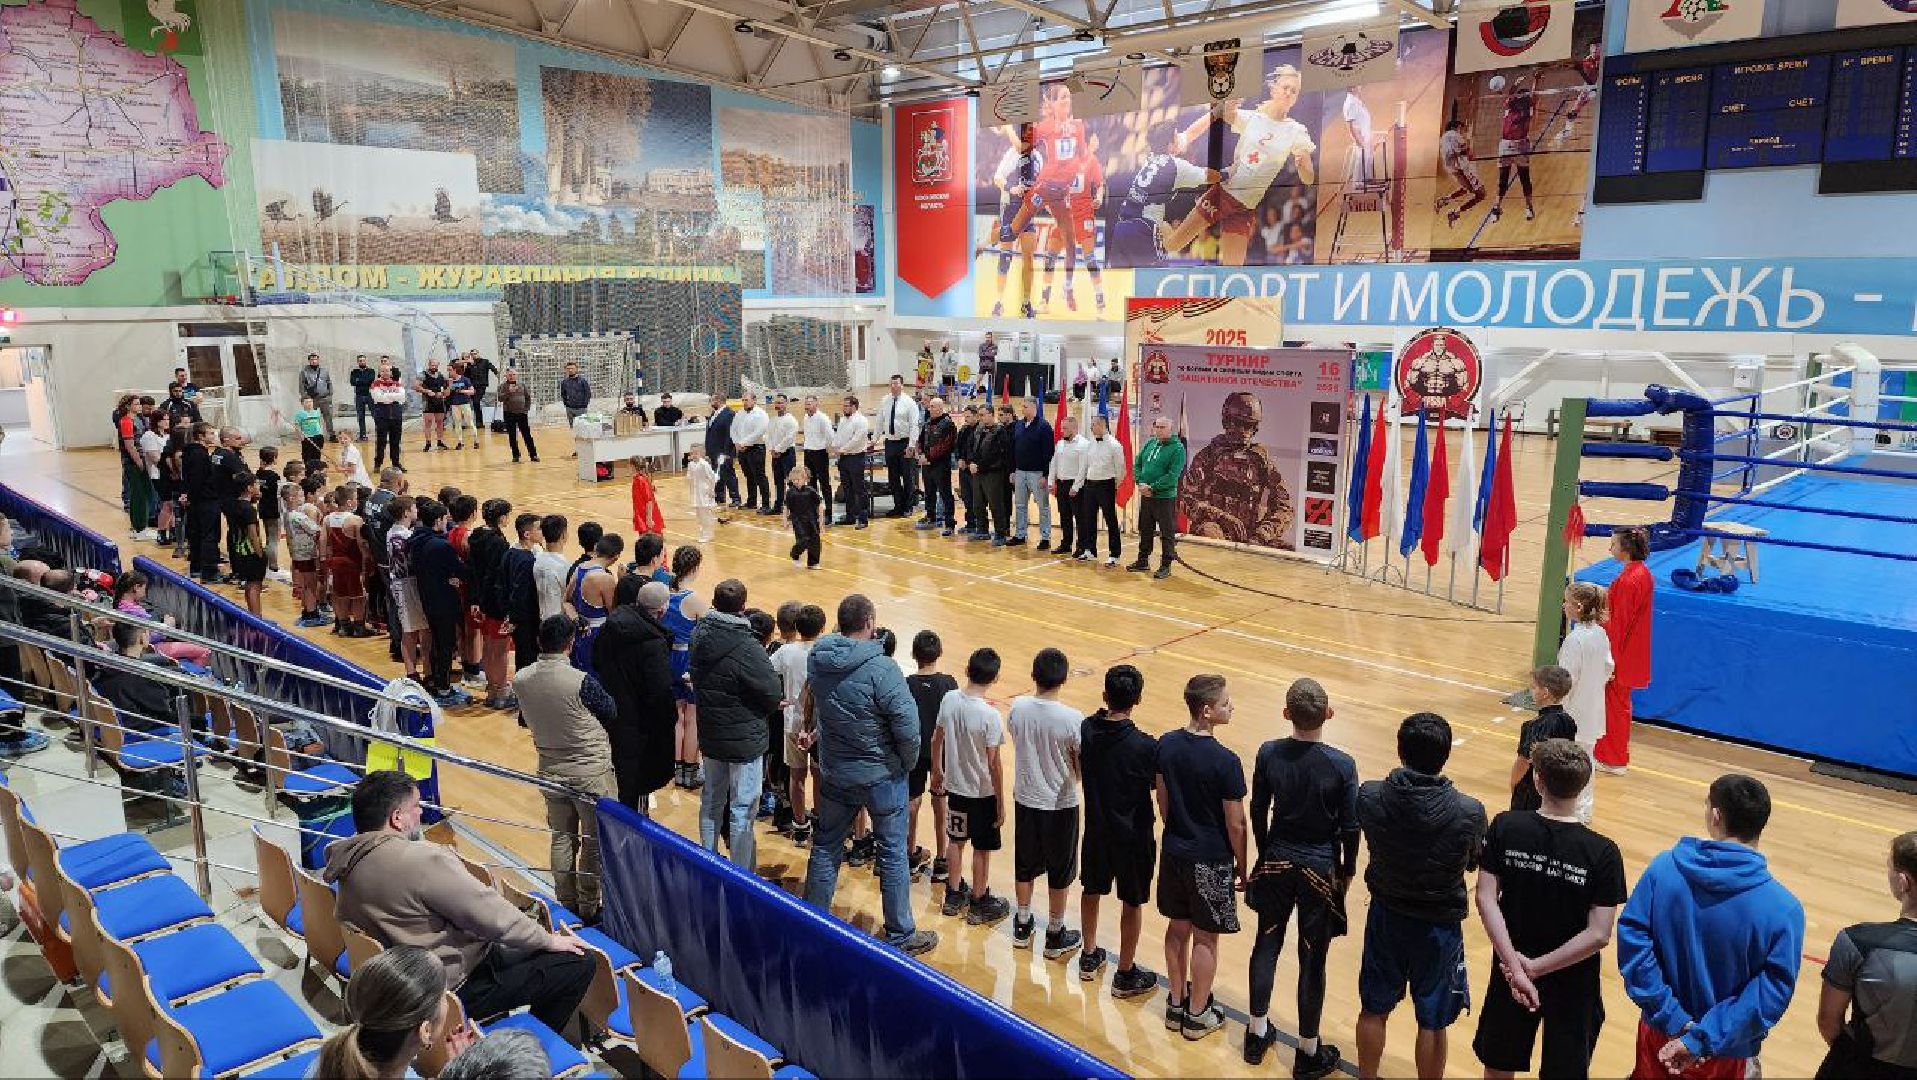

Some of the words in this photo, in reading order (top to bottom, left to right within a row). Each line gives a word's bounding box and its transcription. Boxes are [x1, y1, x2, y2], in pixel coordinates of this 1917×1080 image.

[1777, 60, 1808, 71] ВРЕМЯ
[1860, 55, 1894, 66] ВРЕМЯ
[1675, 73, 1703, 83] ВРЕМЯ
[1333, 272, 1370, 321] И
[1388, 267, 1826, 331] МОЛОДЕЖЬ
[1854, 293, 1882, 302] -
[1207, 328, 1247, 346] 2025
[1207, 353, 1271, 369] ТУРНИР
[1276, 369, 1303, 378] СПОРТА
[1319, 362, 1340, 376] 16
